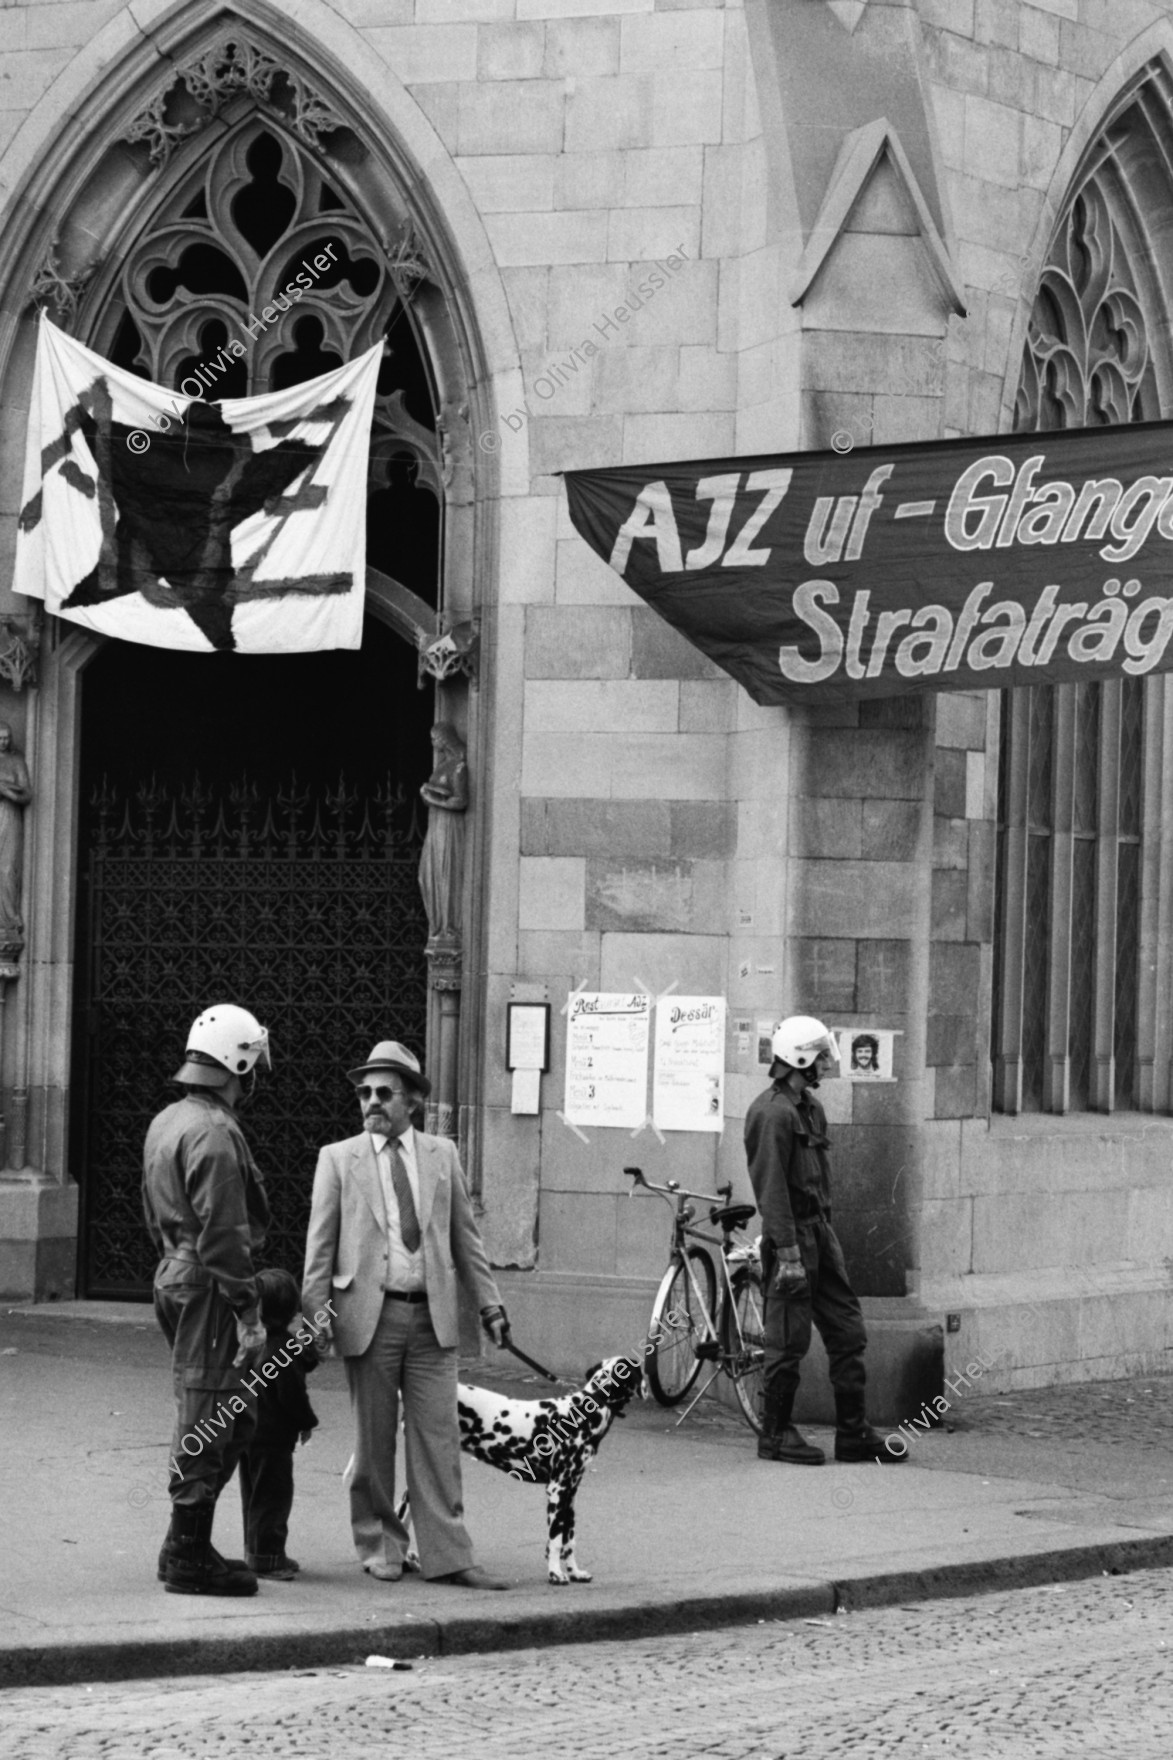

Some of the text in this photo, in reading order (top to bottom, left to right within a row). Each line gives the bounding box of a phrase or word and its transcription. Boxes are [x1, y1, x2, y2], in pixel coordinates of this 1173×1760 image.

[607, 468, 793, 573] AJZ
[803, 463, 895, 565] uf
[778, 578, 1173, 684] Strafaträg
[588, 1056, 593, 1067] 2
[589, 1084, 595, 1098] 3
